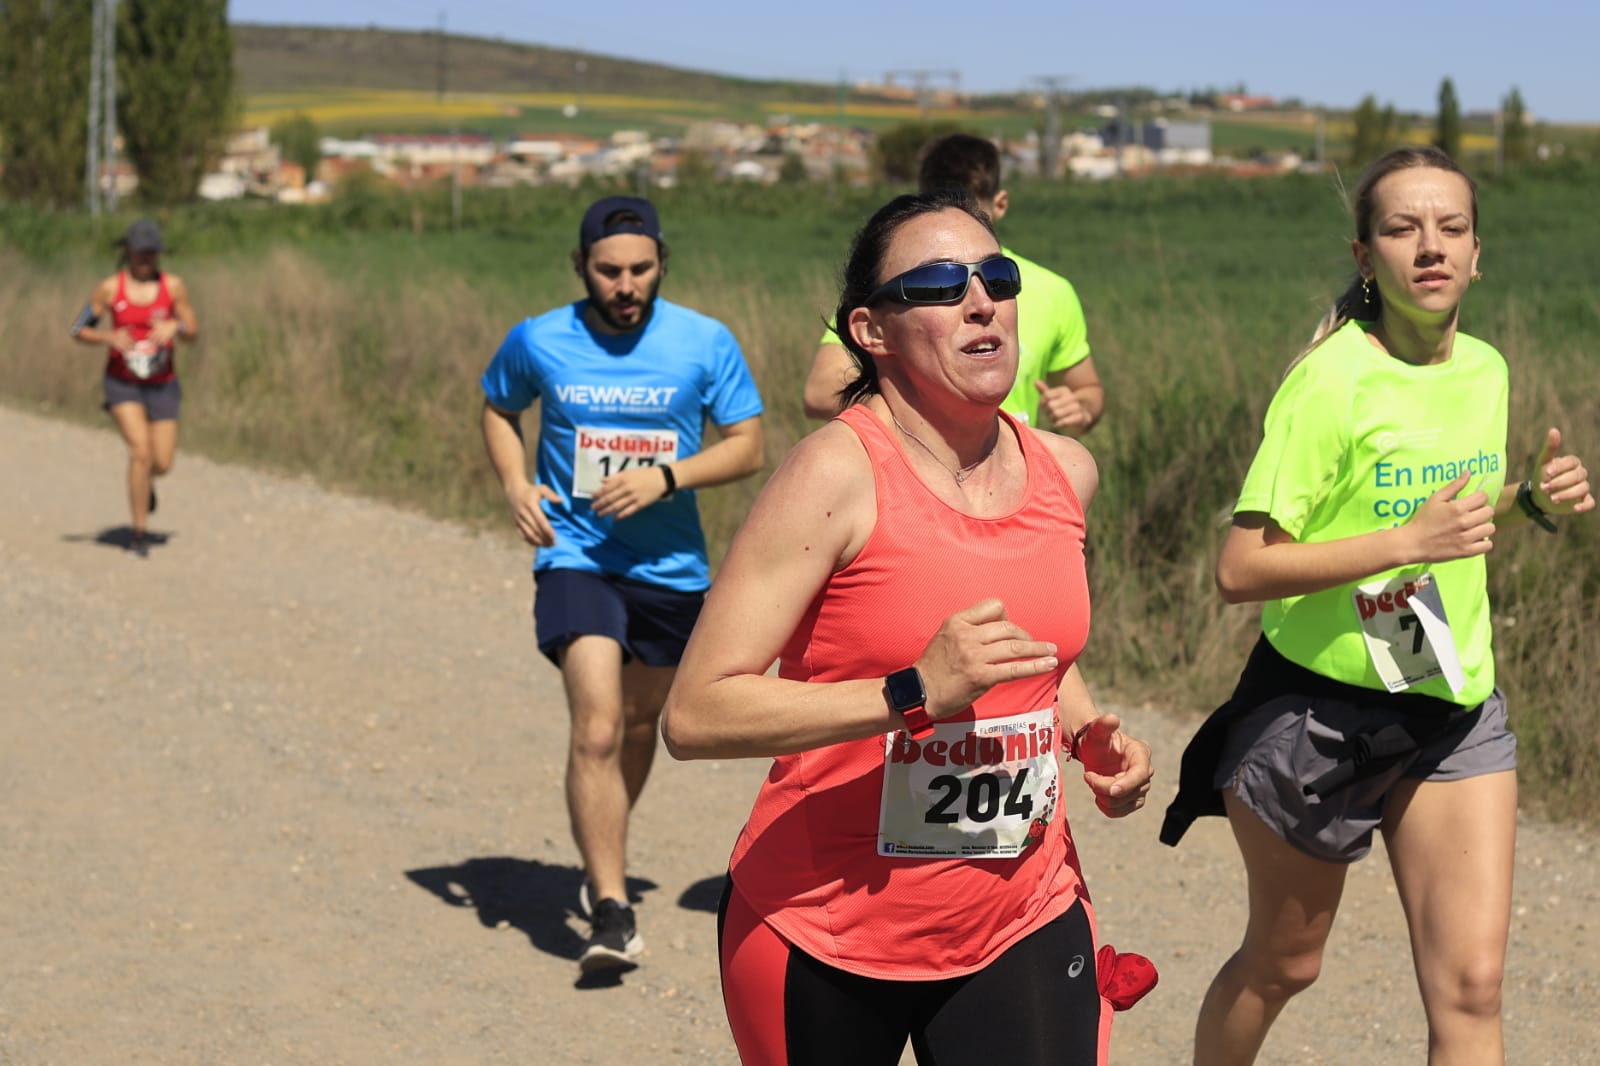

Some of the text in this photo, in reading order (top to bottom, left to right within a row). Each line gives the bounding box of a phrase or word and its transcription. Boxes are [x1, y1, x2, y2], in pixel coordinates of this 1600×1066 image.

[555, 384, 678, 406] VIEWNEXT
[580, 432, 674, 453] bedunia
[1375, 449, 1499, 487] En marcha
[891, 723, 1054, 767] bedunia
[924, 767, 1034, 824] 204
